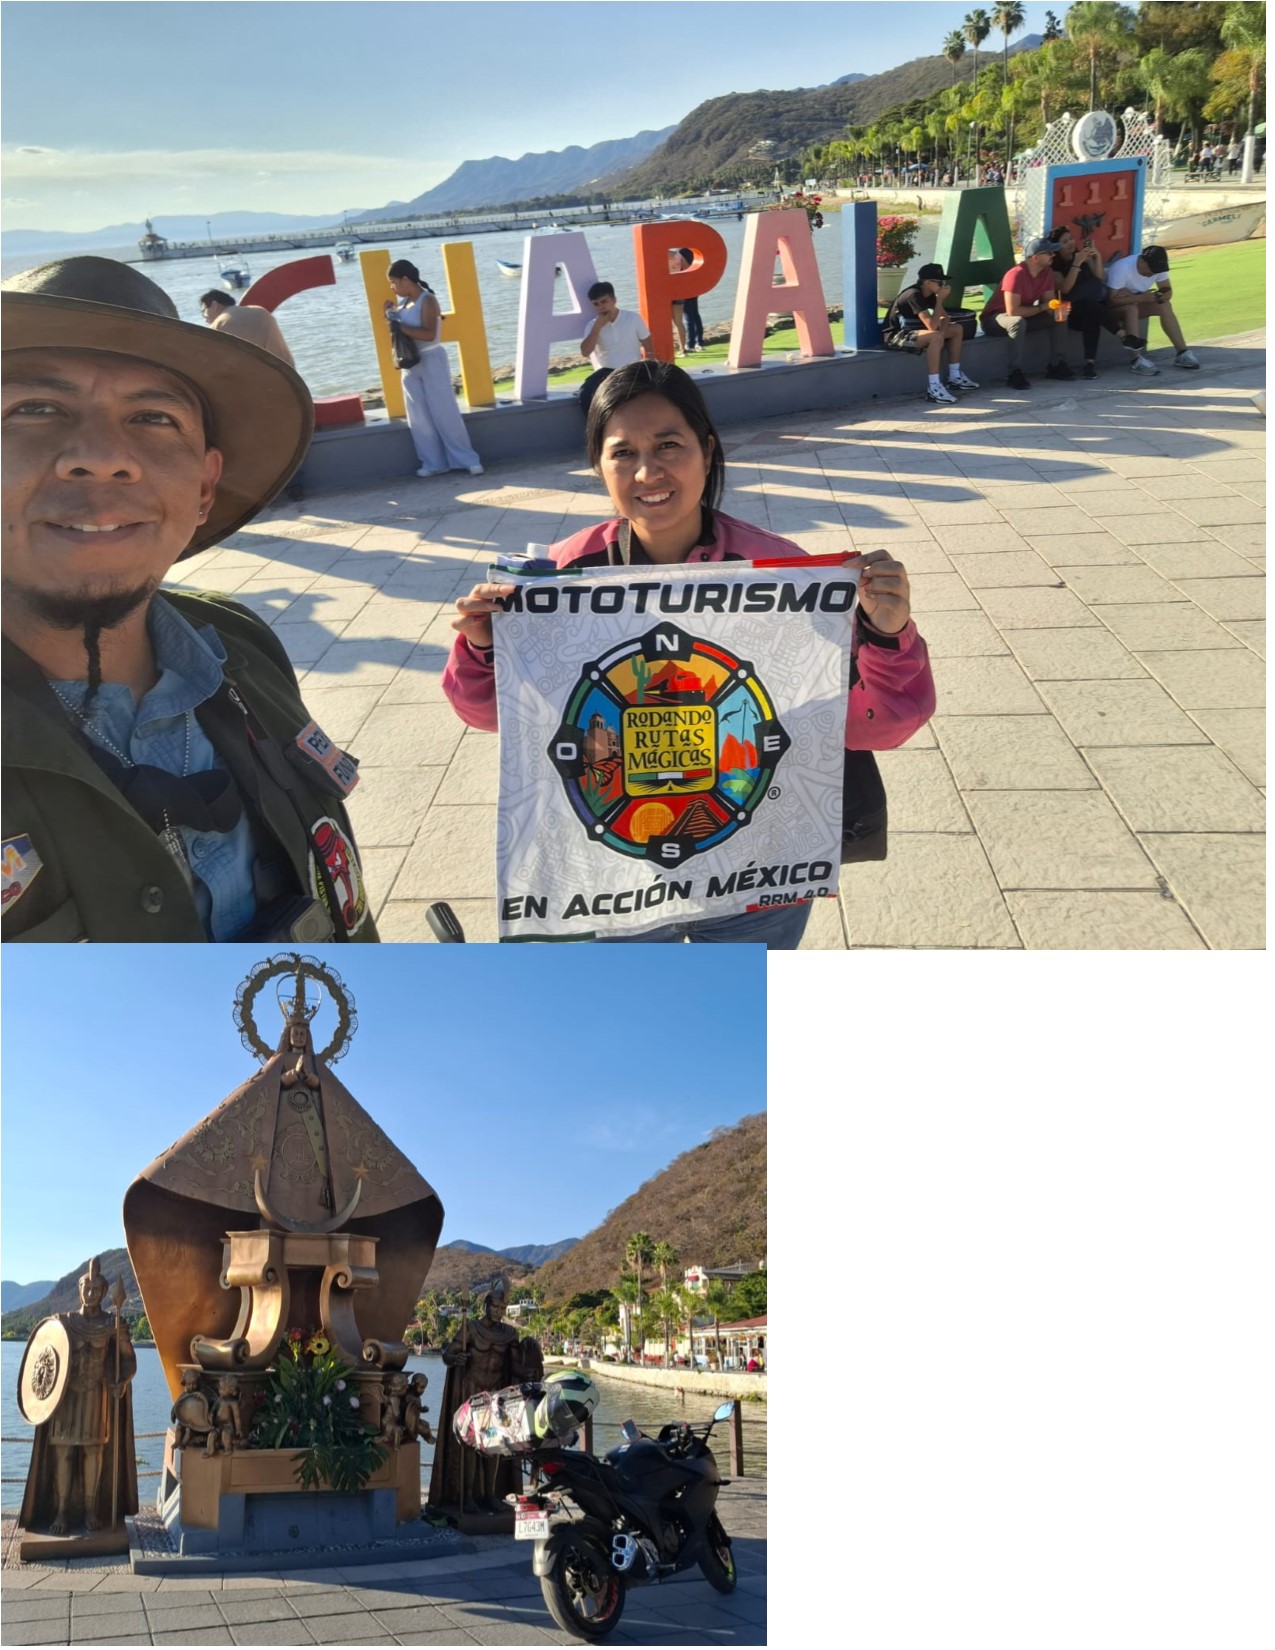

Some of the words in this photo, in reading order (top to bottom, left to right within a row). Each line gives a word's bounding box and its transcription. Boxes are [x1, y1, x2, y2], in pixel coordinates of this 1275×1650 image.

[494, 582, 857, 614] MOTOTURISMO
[656, 634, 679, 651] N
[556, 743, 577, 760] O
[763, 735, 781, 751] E
[660, 843, 680, 858] S
[502, 896, 548, 921] EN
[561, 874, 692, 920] ACCIÓN
[706, 861, 833, 898] MÉXICO
[759, 891, 798, 907] RRM
[803, 887, 829, 899] 4.0
